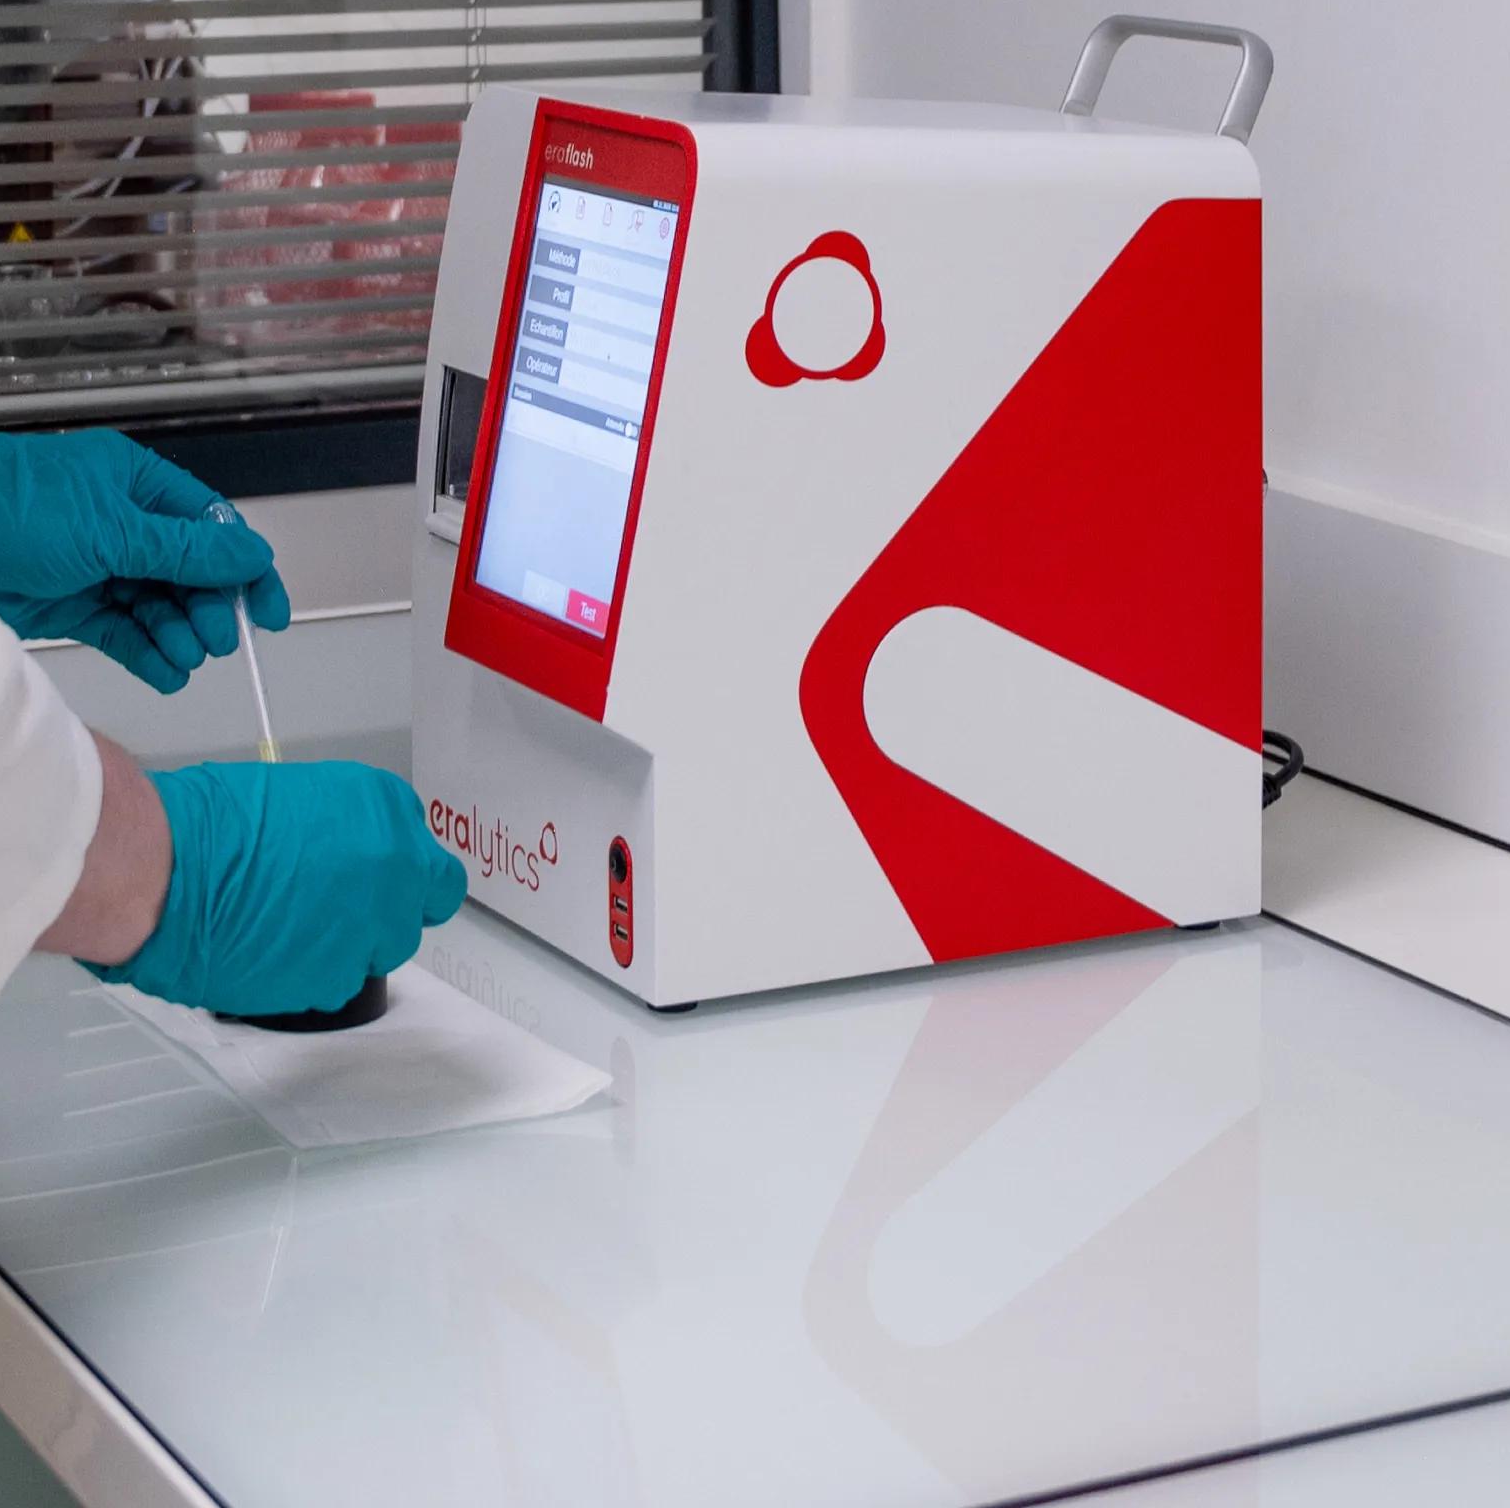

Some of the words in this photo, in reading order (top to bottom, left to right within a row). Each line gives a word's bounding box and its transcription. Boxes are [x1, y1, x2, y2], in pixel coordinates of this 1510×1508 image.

[545, 143, 594, 169] eraflash
[548, 247, 577, 269] Méthode
[552, 286, 571, 305] Profil
[525, 355, 558, 378] Opérateur
[580, 601, 597, 623] Test
[430, 798, 540, 892] eralytics
